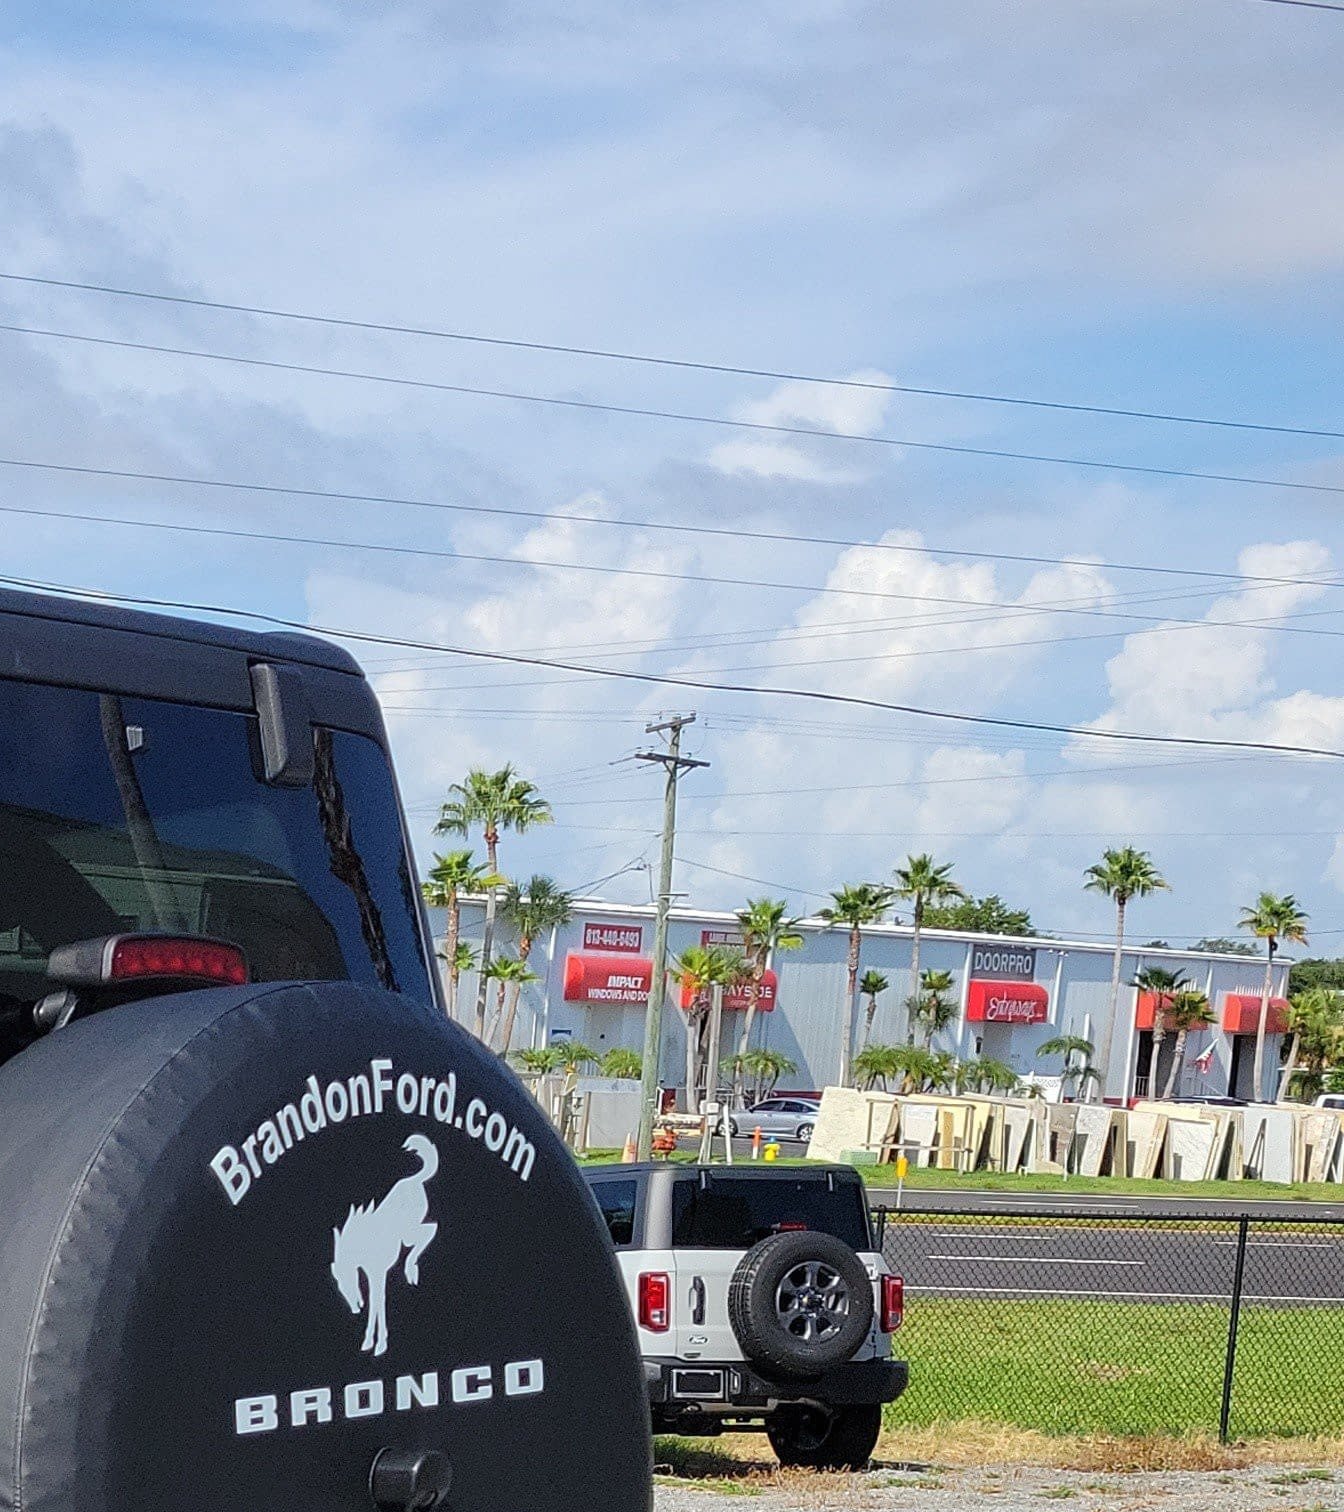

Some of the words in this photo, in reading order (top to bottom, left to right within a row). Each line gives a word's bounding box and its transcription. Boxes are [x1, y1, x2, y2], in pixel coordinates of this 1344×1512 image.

[974, 952, 1032, 973] DOORPRO
[607, 975, 644, 989] IMPACT
[588, 988, 622, 999] WINDOWS
[622, 990, 637, 1001] AND
[210, 1059, 537, 1205] BrandonFord.com
[236, 1360, 543, 1434] BRONCO
